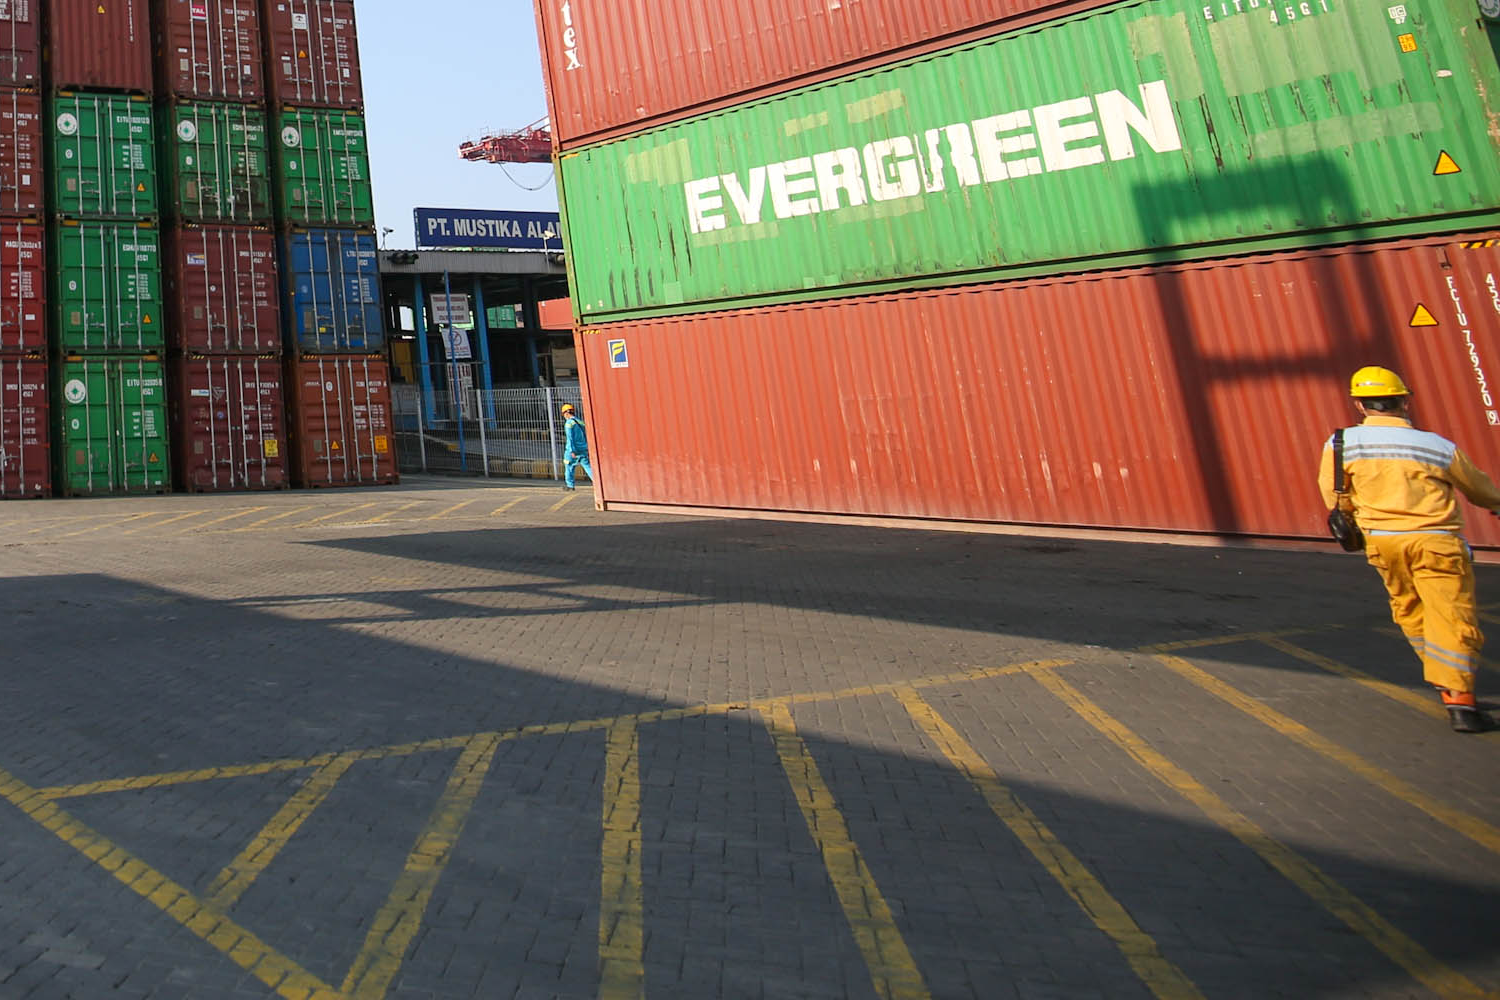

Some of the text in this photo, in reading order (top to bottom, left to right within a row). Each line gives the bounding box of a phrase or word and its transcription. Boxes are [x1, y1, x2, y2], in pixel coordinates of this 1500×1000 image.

[560, 0, 582, 71] tex
[1269, 0, 1328, 24] 45G1
[684, 79, 1183, 234] EVERGREEN
[427, 218, 450, 236] PT.
[453, 218, 522, 238] MUSTIKA
[1445, 276, 1467, 326] FCIU
[1462, 330, 1493, 407] 729320
